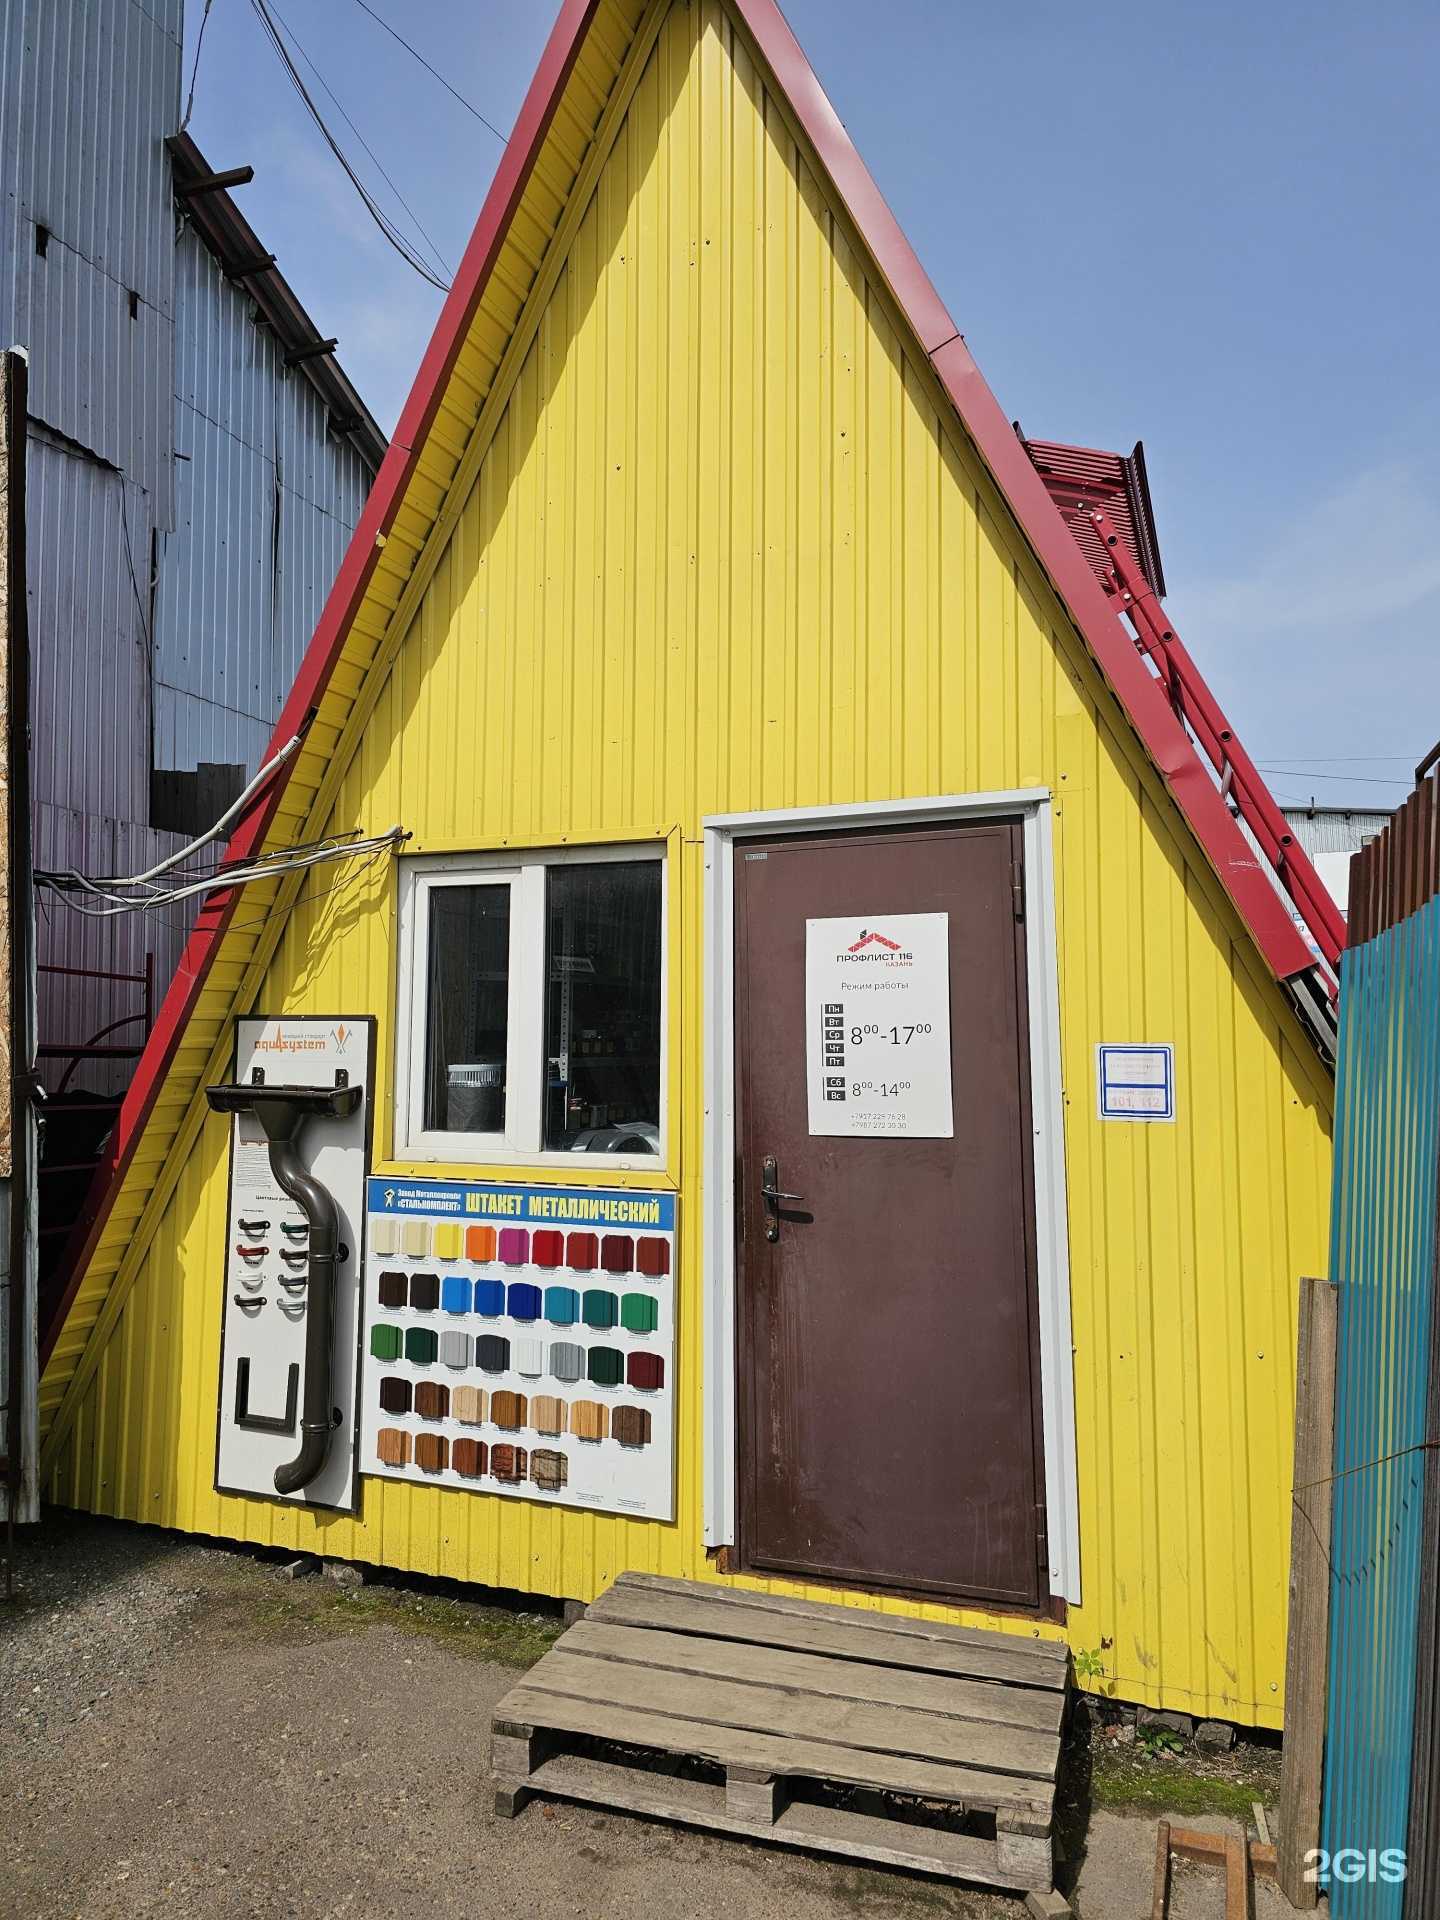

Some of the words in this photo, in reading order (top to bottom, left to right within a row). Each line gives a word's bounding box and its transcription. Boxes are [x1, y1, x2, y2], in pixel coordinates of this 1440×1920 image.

[836, 953, 895, 963] ПРОФЛИСТ
[899, 952, 913, 960] 116
[841, 982, 872, 991] Режим
[874, 980, 909, 991] работы
[828, 1005, 840, 1013] Пн
[829, 1018, 840, 1026] Вт
[829, 1031, 840, 1041] Ср
[829, 1044, 841, 1052] Чт
[829, 1057, 841, 1066] Пт
[830, 1078, 842, 1087] Сб
[831, 1091, 842, 1100] Вс
[397, 1189, 415, 1198] Завод
[465, 1192, 523, 1216] ШТАКЕТ
[528, 1198, 661, 1223] МЕТАЛЛИЧЕСКИЙ
